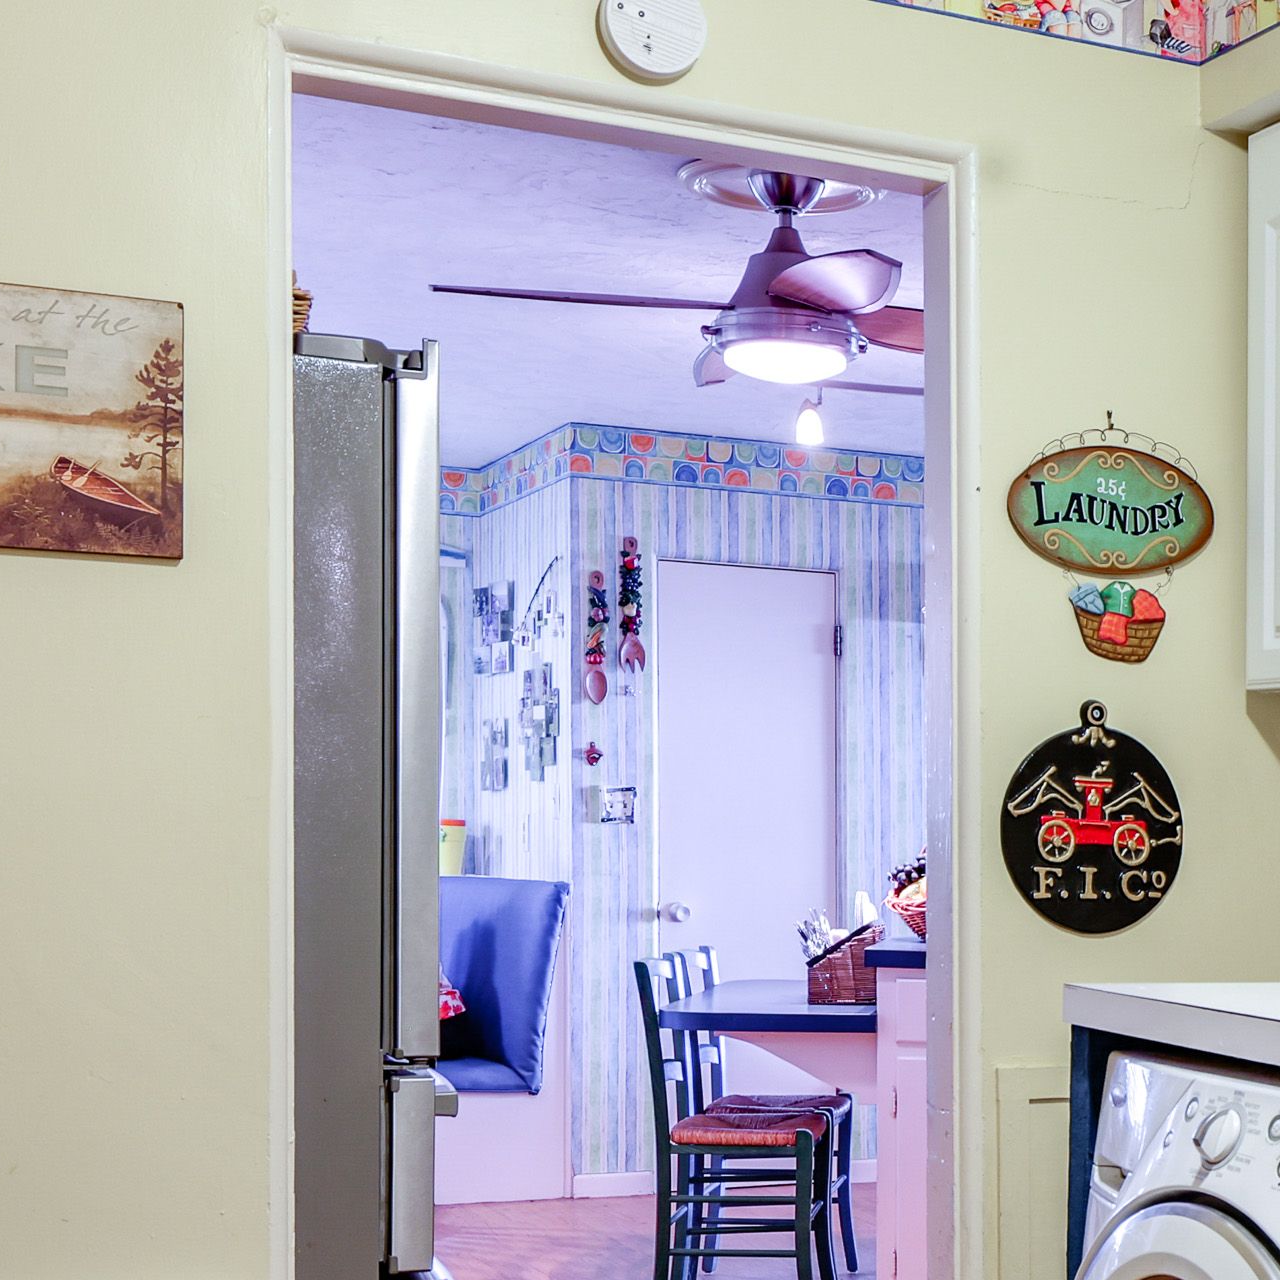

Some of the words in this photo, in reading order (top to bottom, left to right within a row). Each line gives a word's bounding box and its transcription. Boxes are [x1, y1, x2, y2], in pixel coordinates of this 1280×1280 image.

[12, 299, 63, 326] at
[76, 302, 140, 337] the
[1096, 475, 1127, 500] 25¢
[1029, 480, 1186, 537] LAUNDRY
